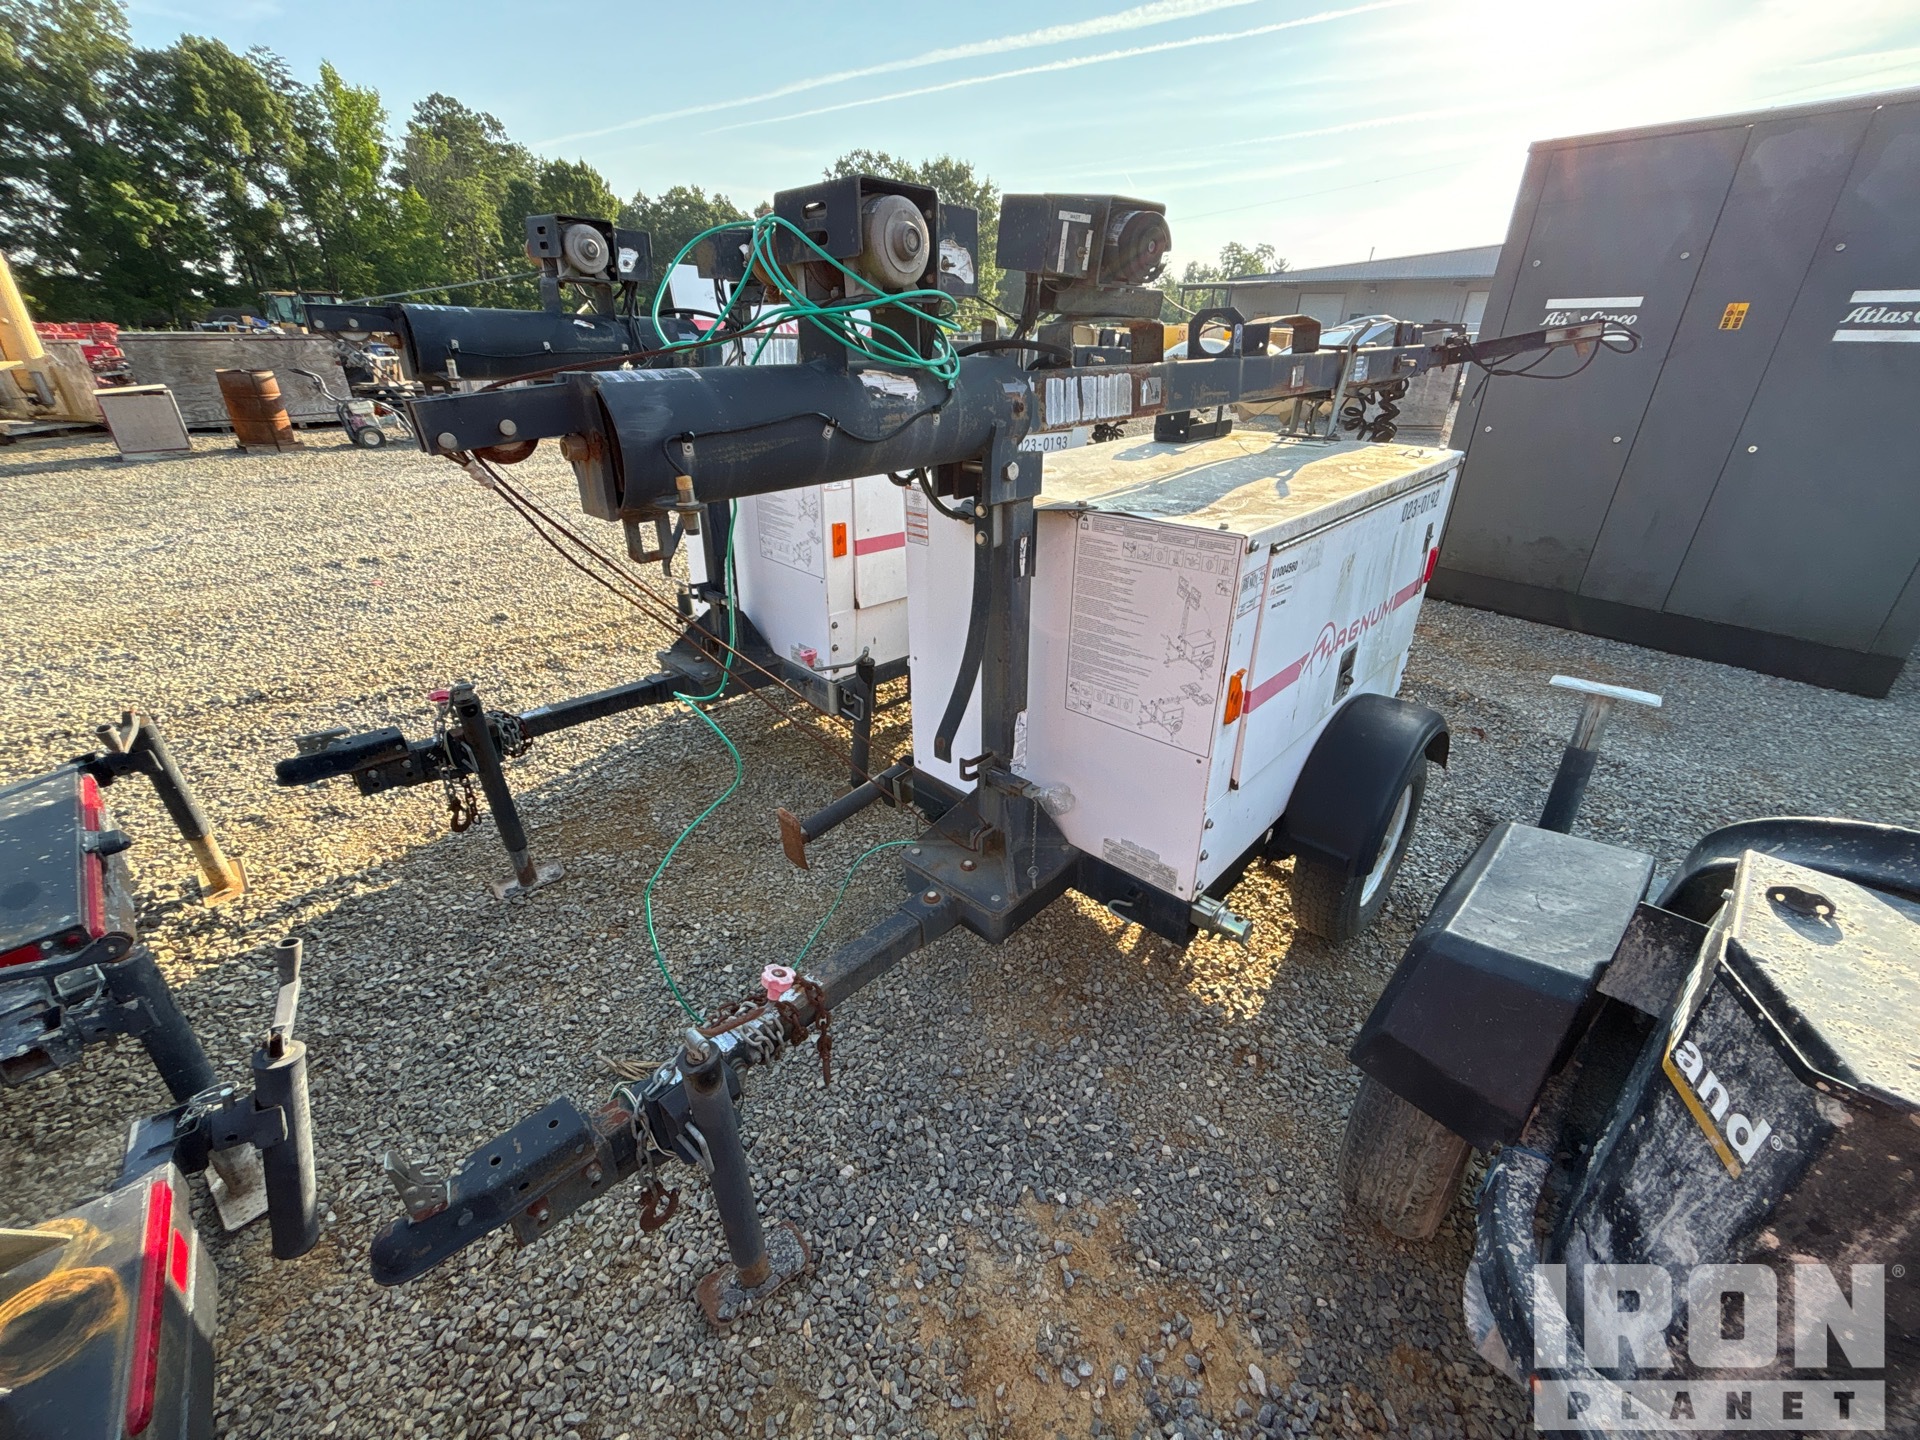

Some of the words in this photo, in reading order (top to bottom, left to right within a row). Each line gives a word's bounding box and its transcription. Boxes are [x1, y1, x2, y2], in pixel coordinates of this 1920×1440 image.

[1540, 311, 1589, 326] Atls
[1839, 306, 1913, 324] Atlas
[1401, 489, 1441, 522] 023-0192
[1303, 594, 1395, 678] MAGNUM
